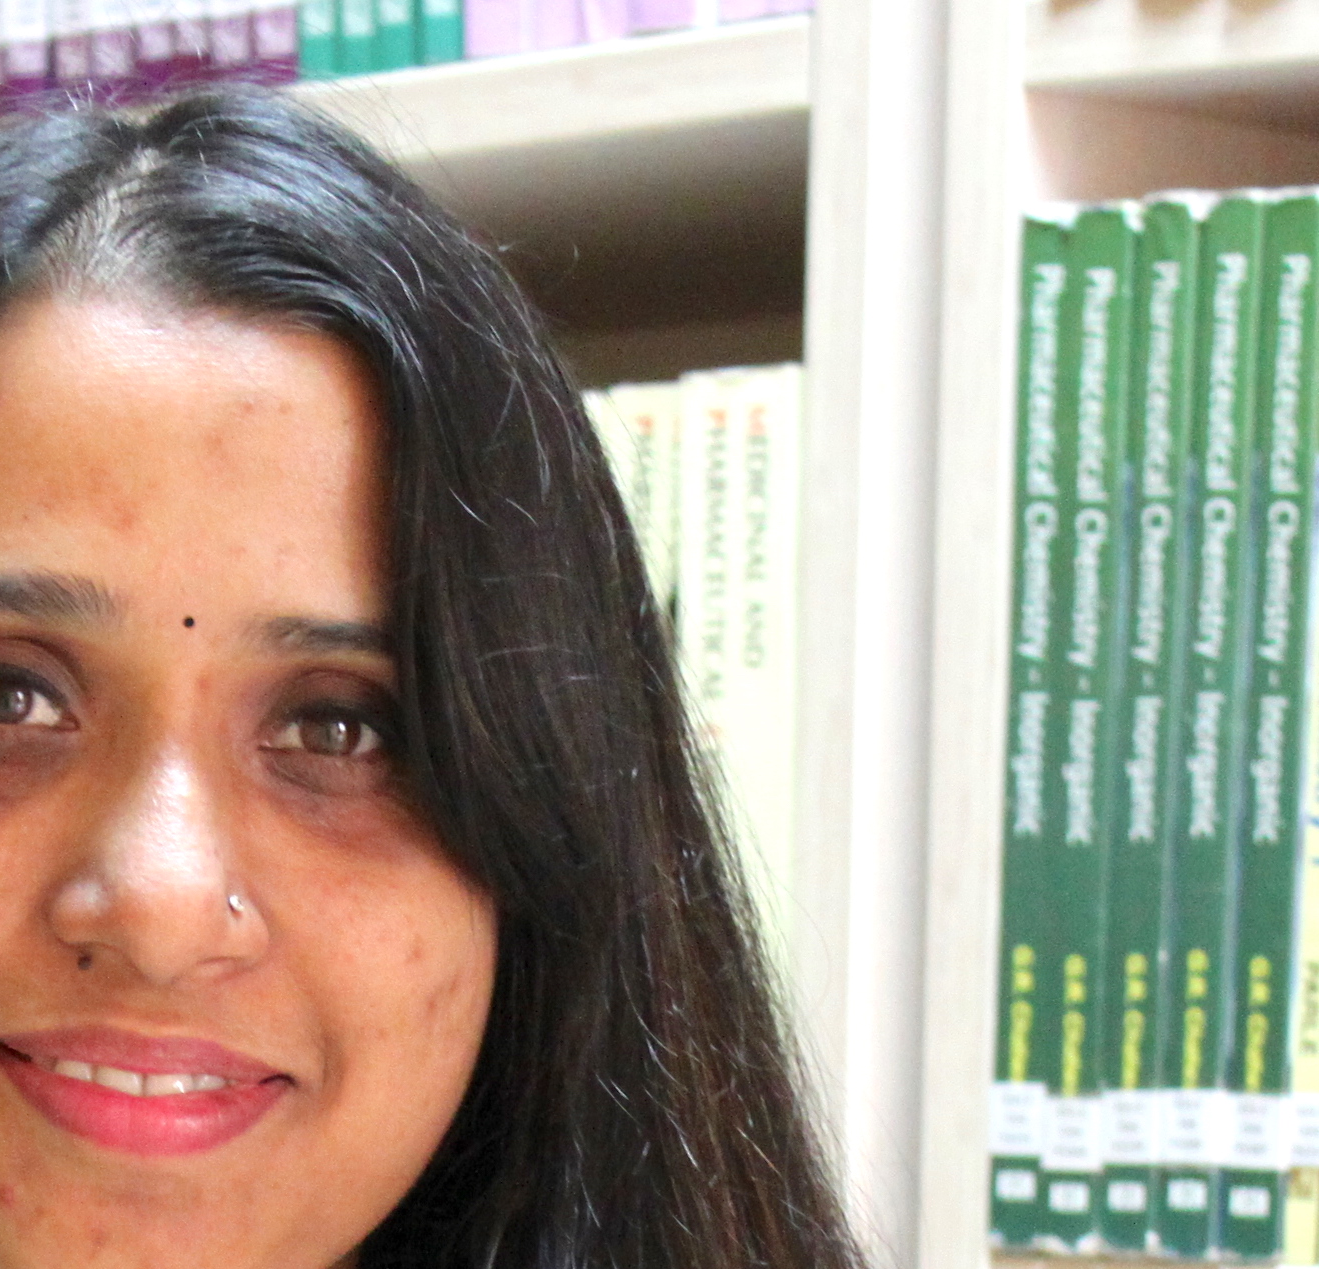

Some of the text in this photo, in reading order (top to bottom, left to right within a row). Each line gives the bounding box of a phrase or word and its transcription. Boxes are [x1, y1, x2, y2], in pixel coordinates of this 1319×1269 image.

[1027, 263, 1067, 496] Pharmaceutical
[1076, 267, 1117, 502] Pharmaceutical
[1143, 261, 1181, 497] Pharmaceutical
[1206, 251, 1249, 491] Pharmaceutical
[1270, 253, 1312, 493] Pharmaceutical
[701, 407, 728, 702] PHARMACEUTICAL
[743, 404, 769, 671] MEDICINAL AND
[1017, 501, 1058, 659] Chemistry
[1068, 508, 1108, 667] Chemistry
[1133, 503, 1173, 663] Chemistry
[1194, 496, 1237, 659] Chemistry
[1260, 500, 1300, 662] Chemistry
[1011, 692, 1049, 833] Inorganic
[1062, 700, 1100, 843] Inorganic
[1126, 696, 1163, 841] Inorganic
[1187, 691, 1225, 836] Inorganic
[1251, 695, 1289, 842] Inorganic
